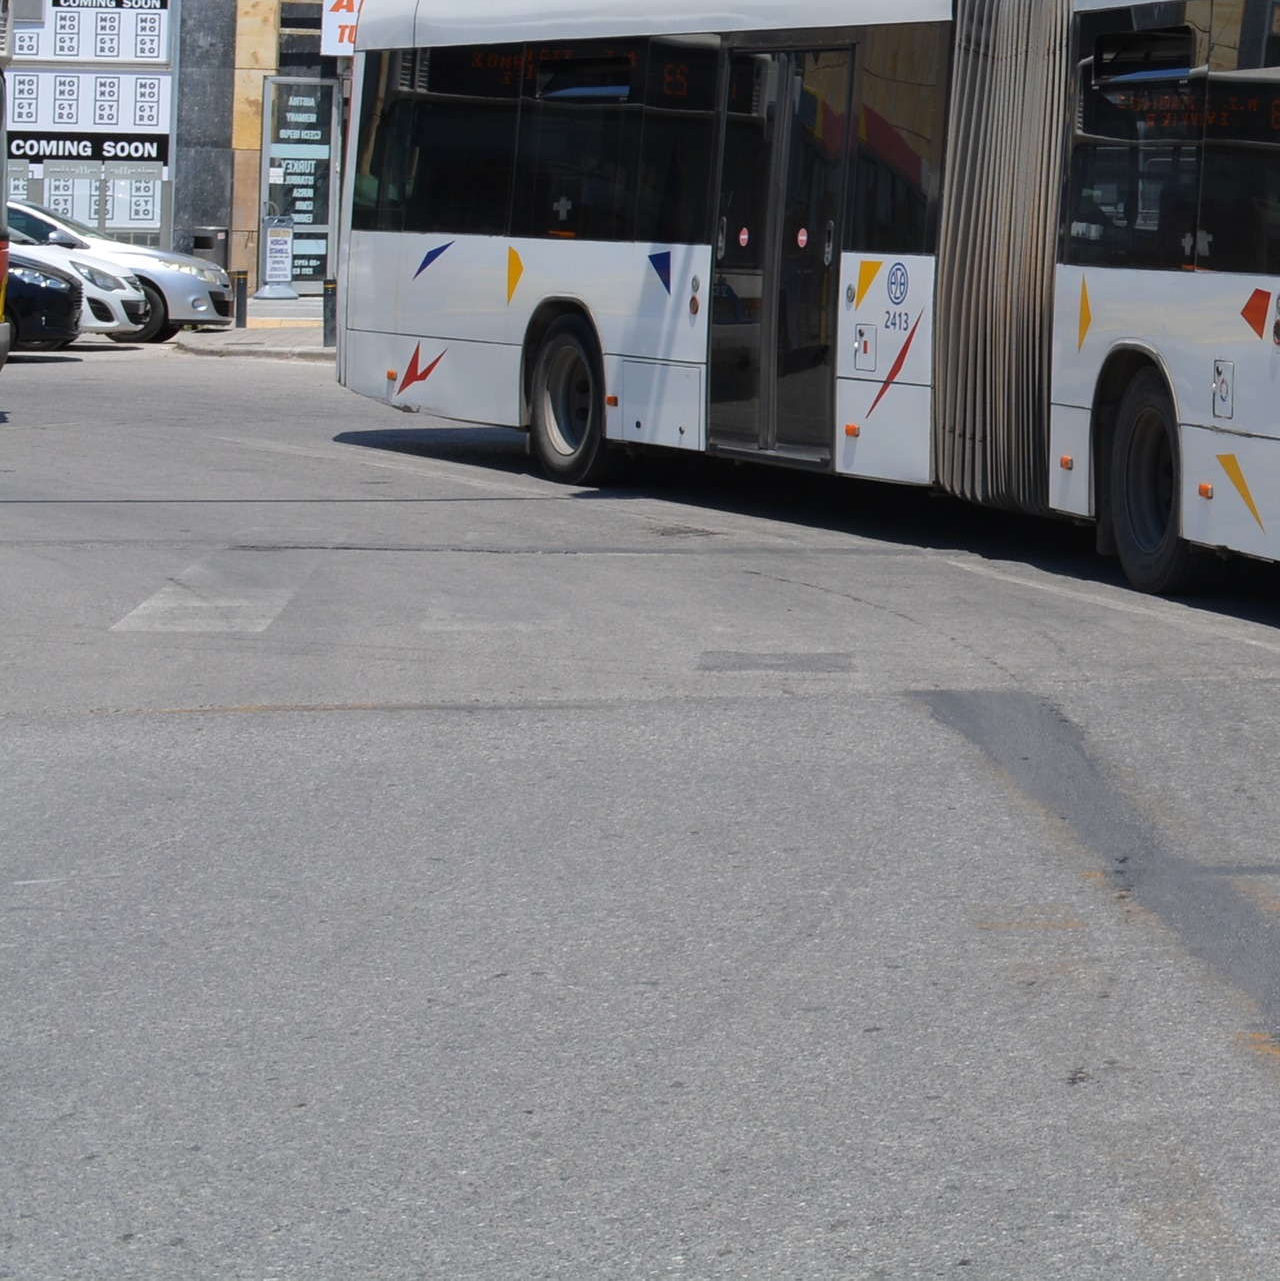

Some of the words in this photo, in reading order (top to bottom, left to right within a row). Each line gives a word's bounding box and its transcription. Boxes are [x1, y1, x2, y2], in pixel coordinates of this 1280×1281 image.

[11, 139, 92, 156] COMING
[102, 141, 157, 157] SOON
[884, 310, 909, 331] 2413
